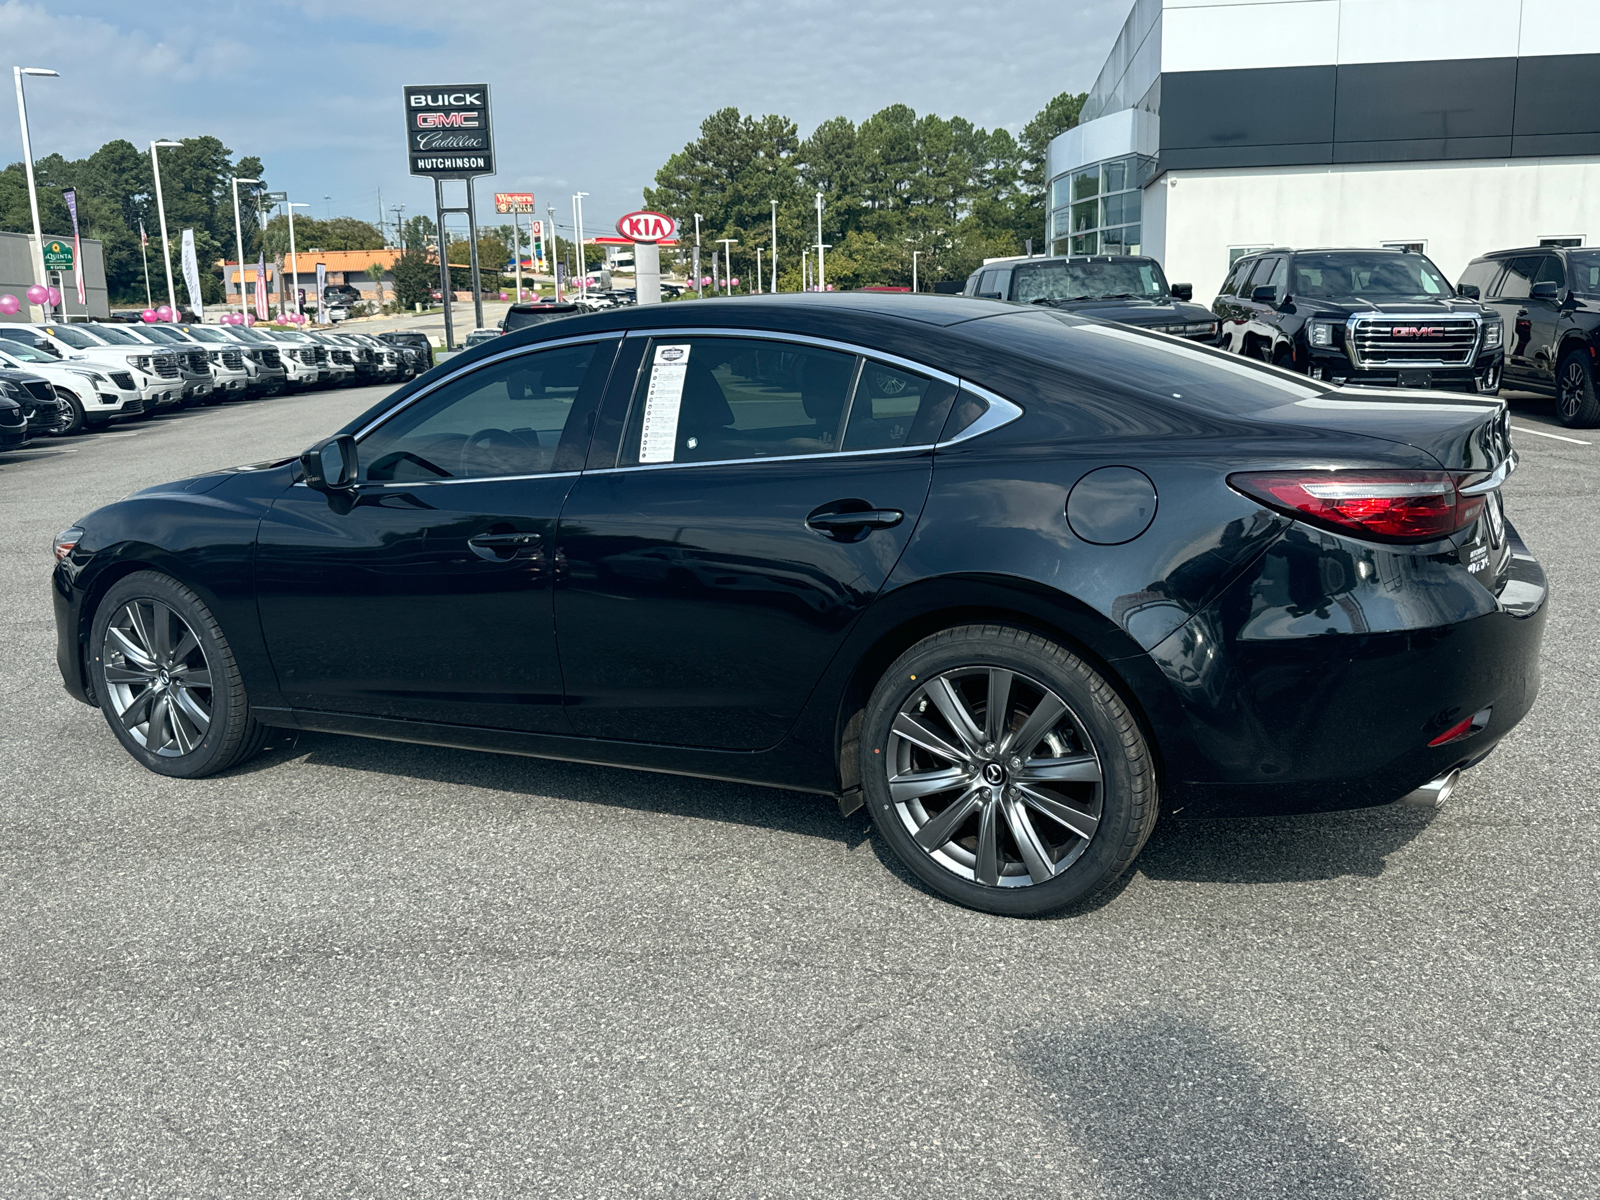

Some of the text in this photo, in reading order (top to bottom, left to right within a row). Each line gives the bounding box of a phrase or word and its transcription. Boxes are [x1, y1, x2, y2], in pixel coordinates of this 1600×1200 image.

[410, 93, 482, 107] BUICK
[416, 111, 479, 128] GMC
[416, 130, 482, 151] Cadillac
[417, 157, 485, 169] HUTCHINSON
[627, 218, 666, 236] KIA
[1392, 326, 1445, 338] GMC
